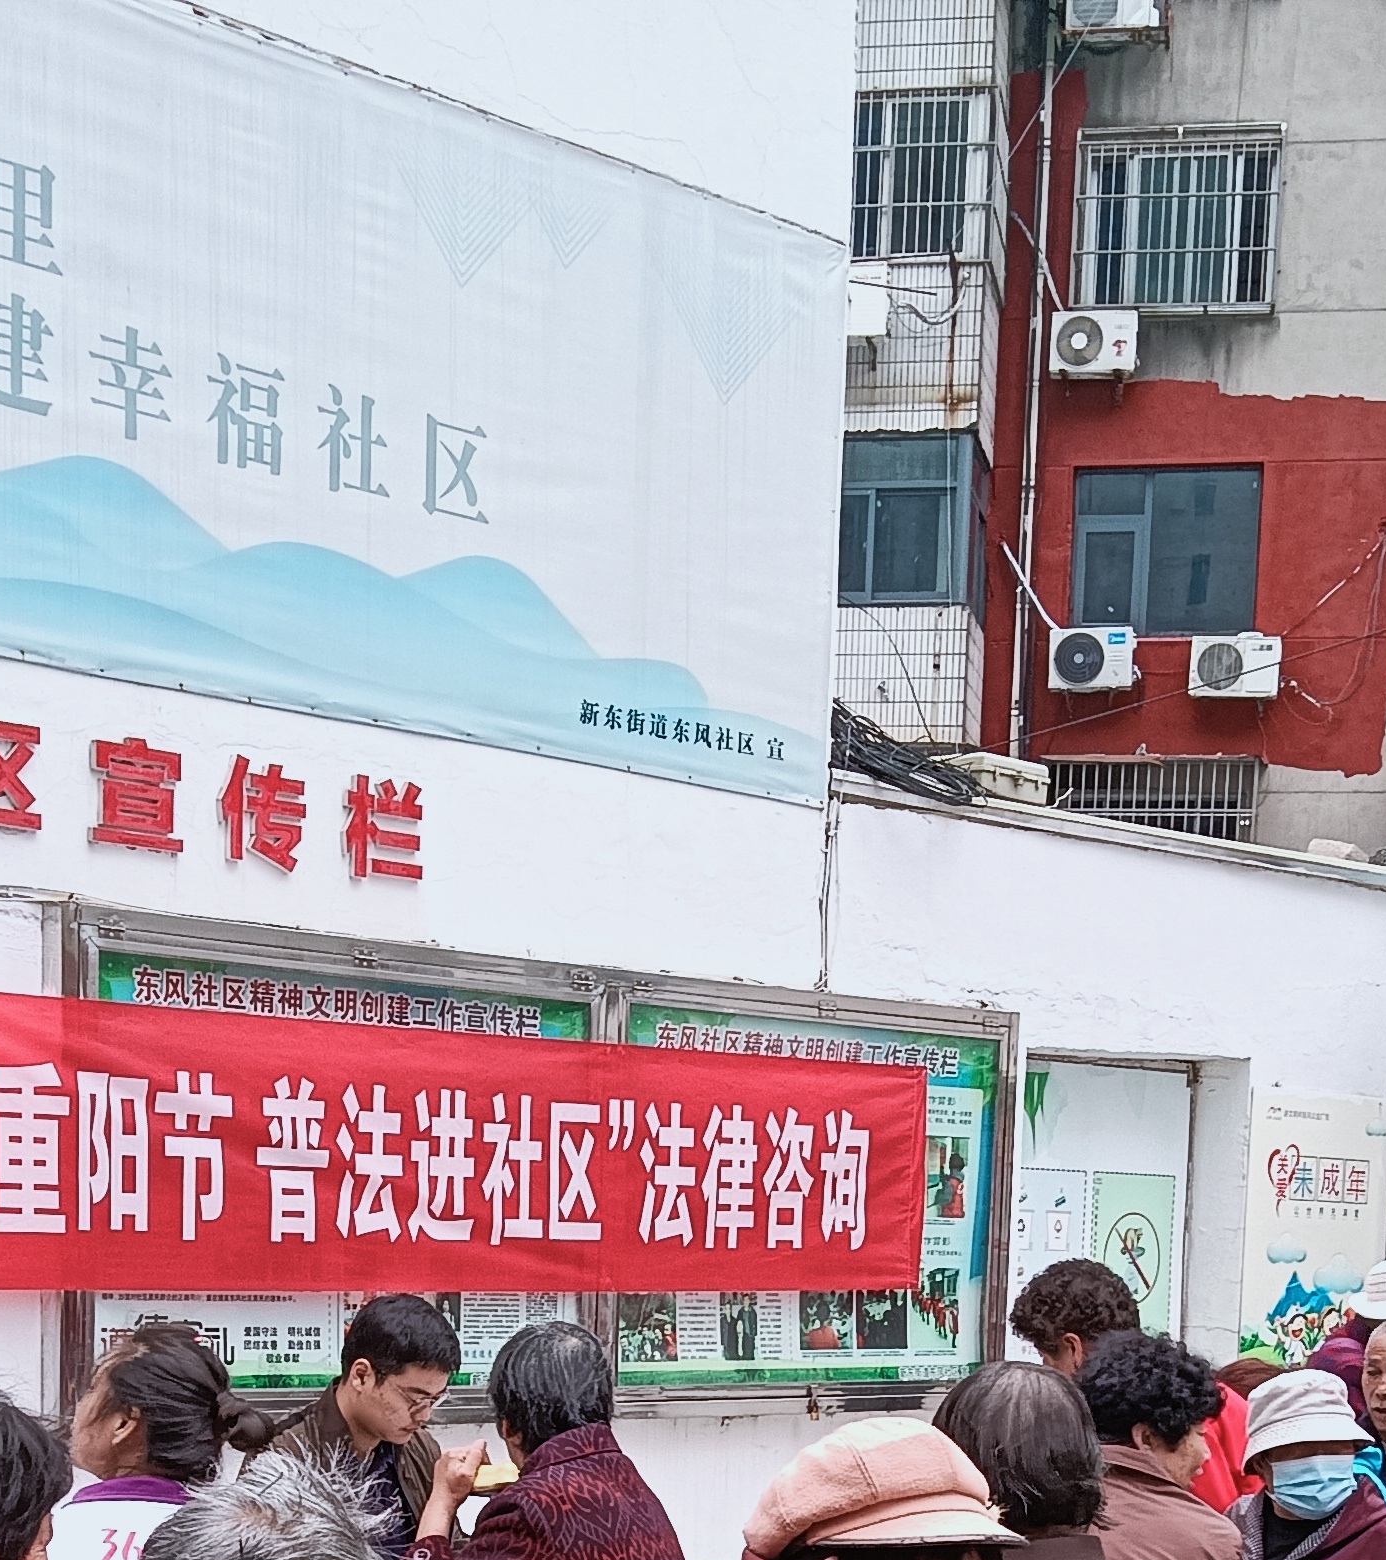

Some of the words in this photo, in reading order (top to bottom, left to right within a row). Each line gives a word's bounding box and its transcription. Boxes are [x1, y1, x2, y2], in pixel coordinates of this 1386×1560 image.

[579, 699, 754, 755] 新东街道东风社区
[767, 737, 785, 761] 宣
[134, 966, 541, 1037] 东风社区精神文明创建工作宣传栏
[658, 1023, 958, 1076] 东风社区精神文明创建工作宣传栏
[256, 1075, 870, 1251] 普法进社区”法律咨询
[1293, 1162, 1367, 1201] 未成年
